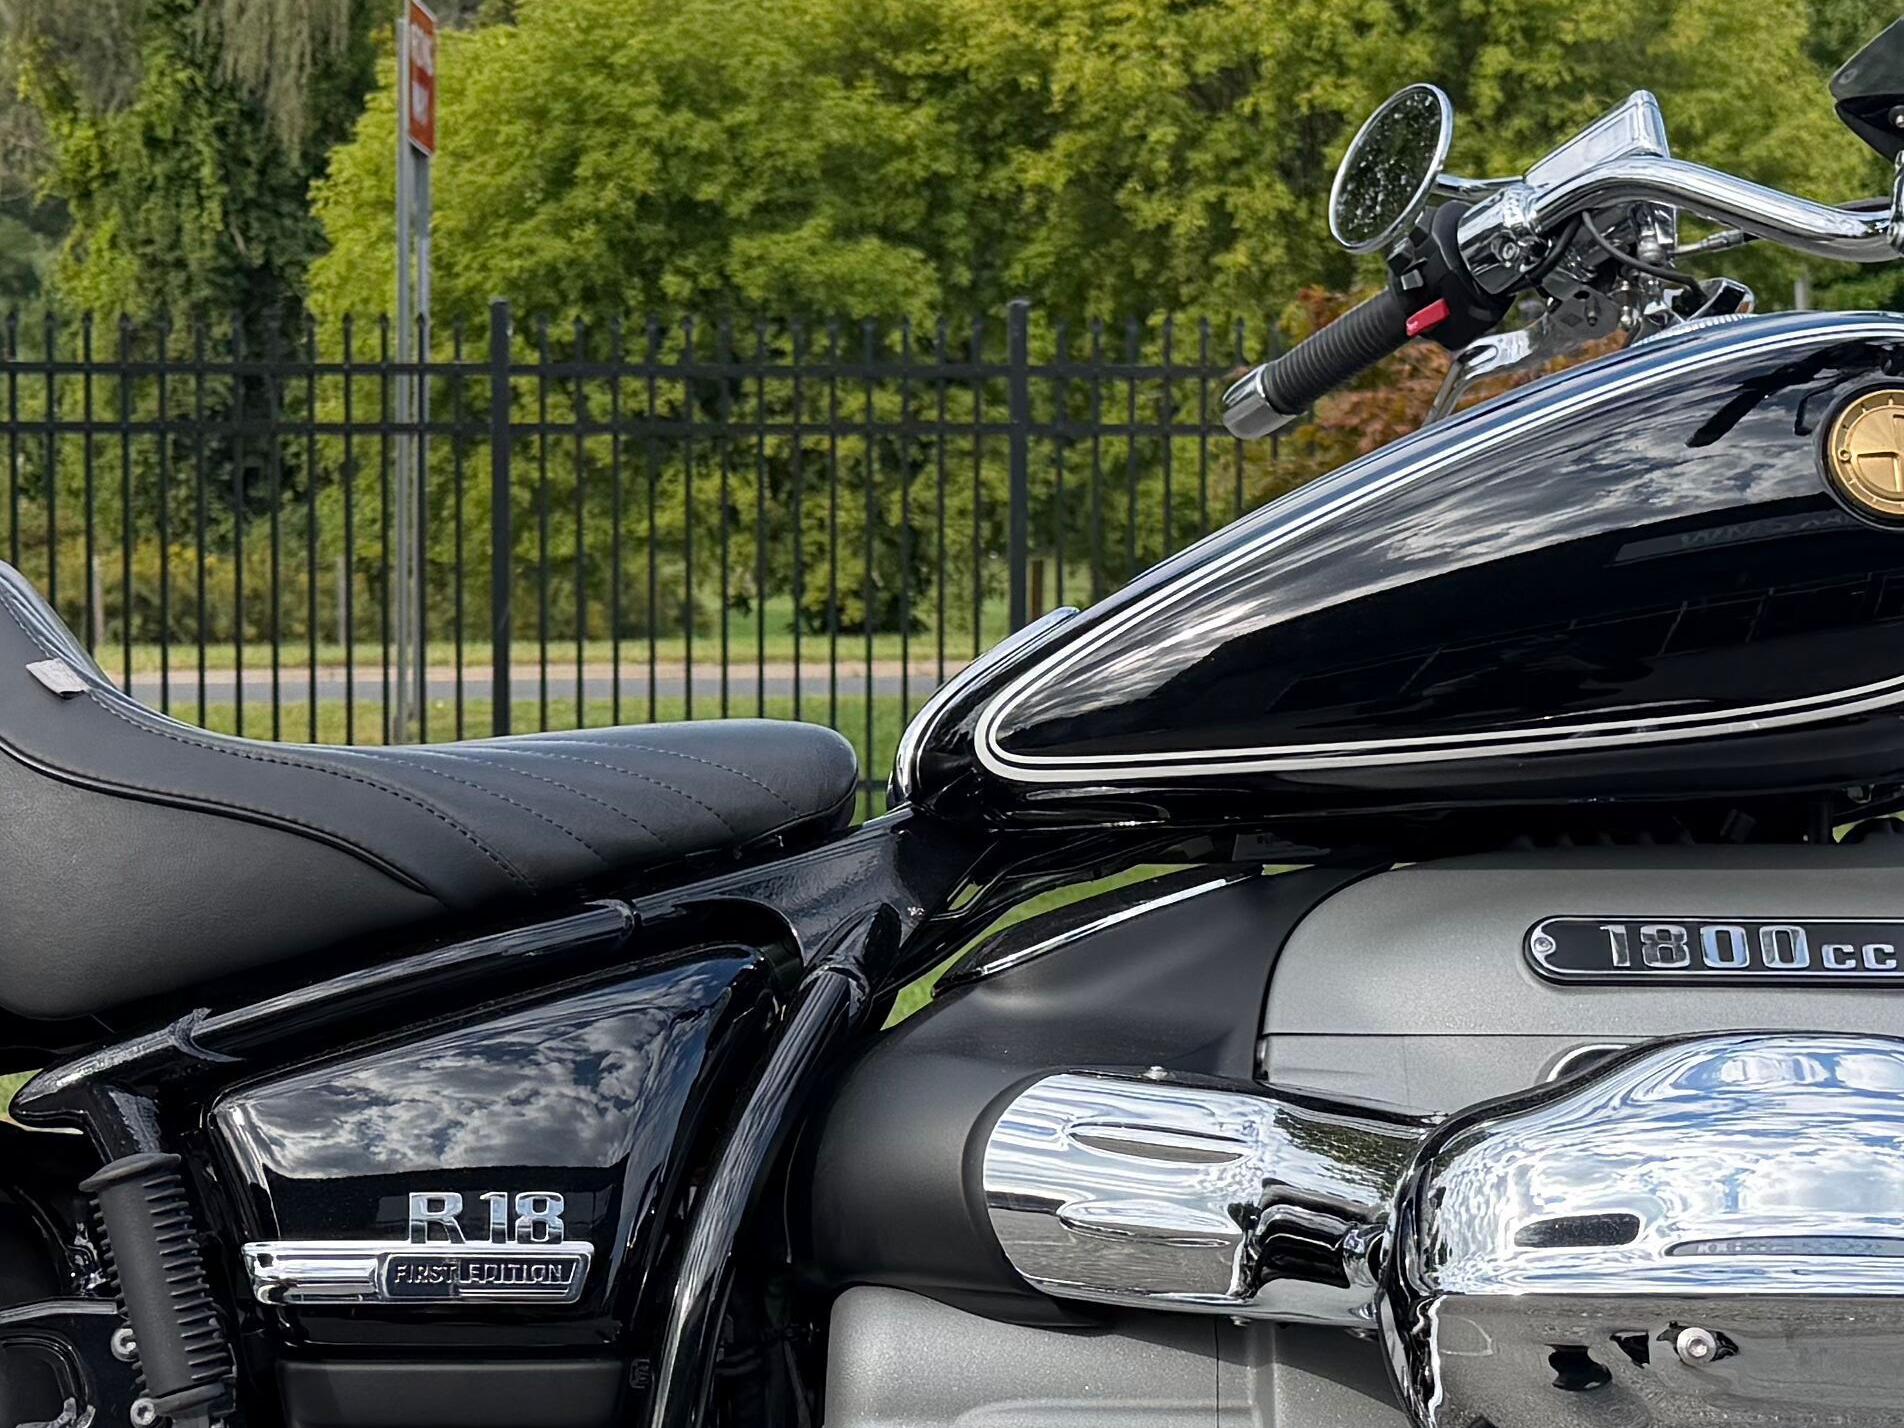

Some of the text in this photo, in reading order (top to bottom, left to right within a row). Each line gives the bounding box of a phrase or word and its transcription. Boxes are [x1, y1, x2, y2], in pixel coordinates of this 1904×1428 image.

[1599, 923, 1898, 971] 1800cc
[394, 1263, 564, 1284] FIRST EDITION
